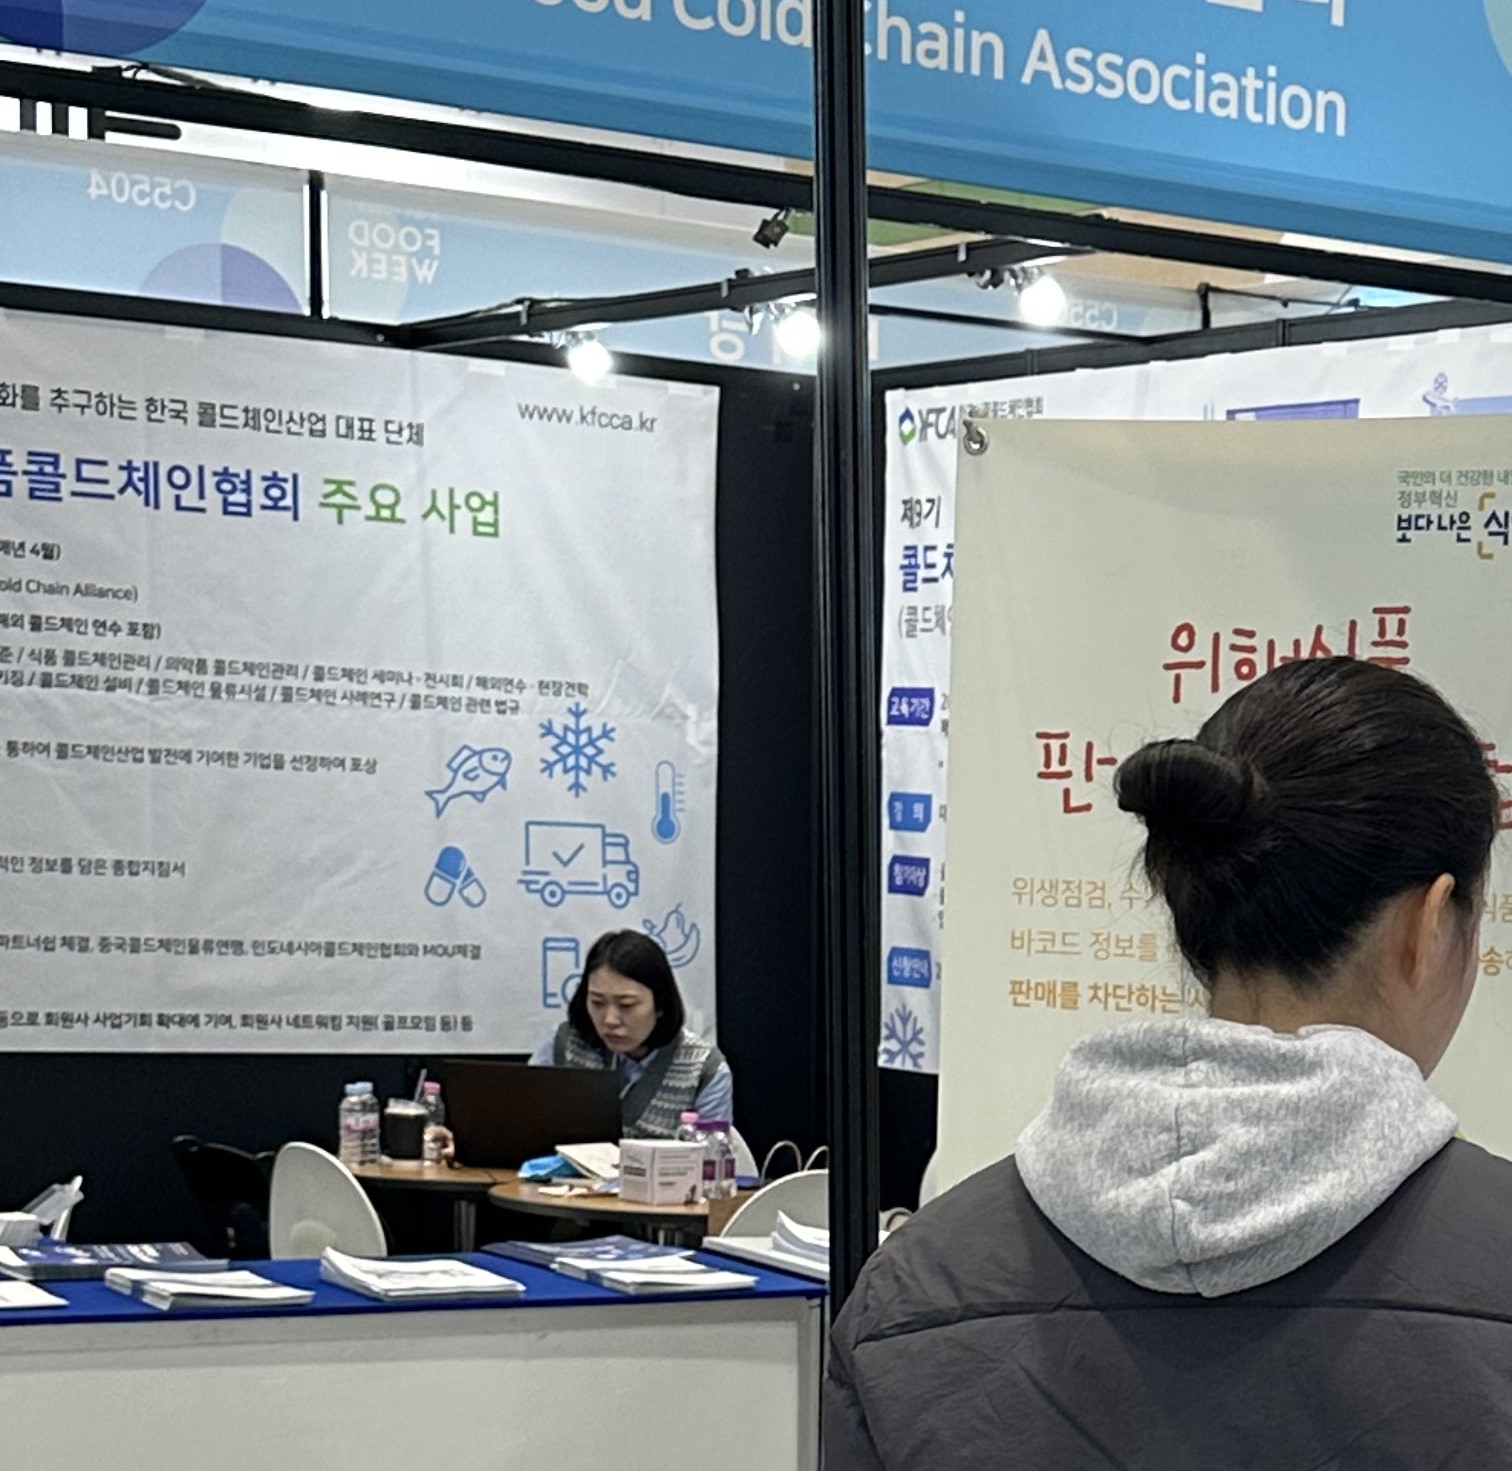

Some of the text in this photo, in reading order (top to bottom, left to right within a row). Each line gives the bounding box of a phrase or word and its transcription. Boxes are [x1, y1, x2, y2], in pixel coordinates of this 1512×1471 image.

[864, 0, 1005, 81] hain
[1021, 27, 1347, 137] Association
[49, 387, 138, 421] 추구하는
[145, 396, 189, 425] 한국
[197, 403, 327, 438] 콜드체인산업
[335, 415, 377, 442] 대표
[384, 420, 425, 447] 단체
[518, 403, 658, 434] www.kfcca.kr
[319, 477, 406, 526] 주요
[421, 486, 500, 538] 사업
[1397, 489, 1458, 509] 정부혁신
[26, 578, 70, 597] Chain
[73, 583, 139, 603] Alliance)
[1010, 877, 1113, 910] 위생점검,
[1010, 928, 1082, 957] 바코드
[1089, 930, 1158, 963] 정보를
[1009, 978, 1082, 1011] 판매를
[1088, 981, 1183, 1014] 차단하는
